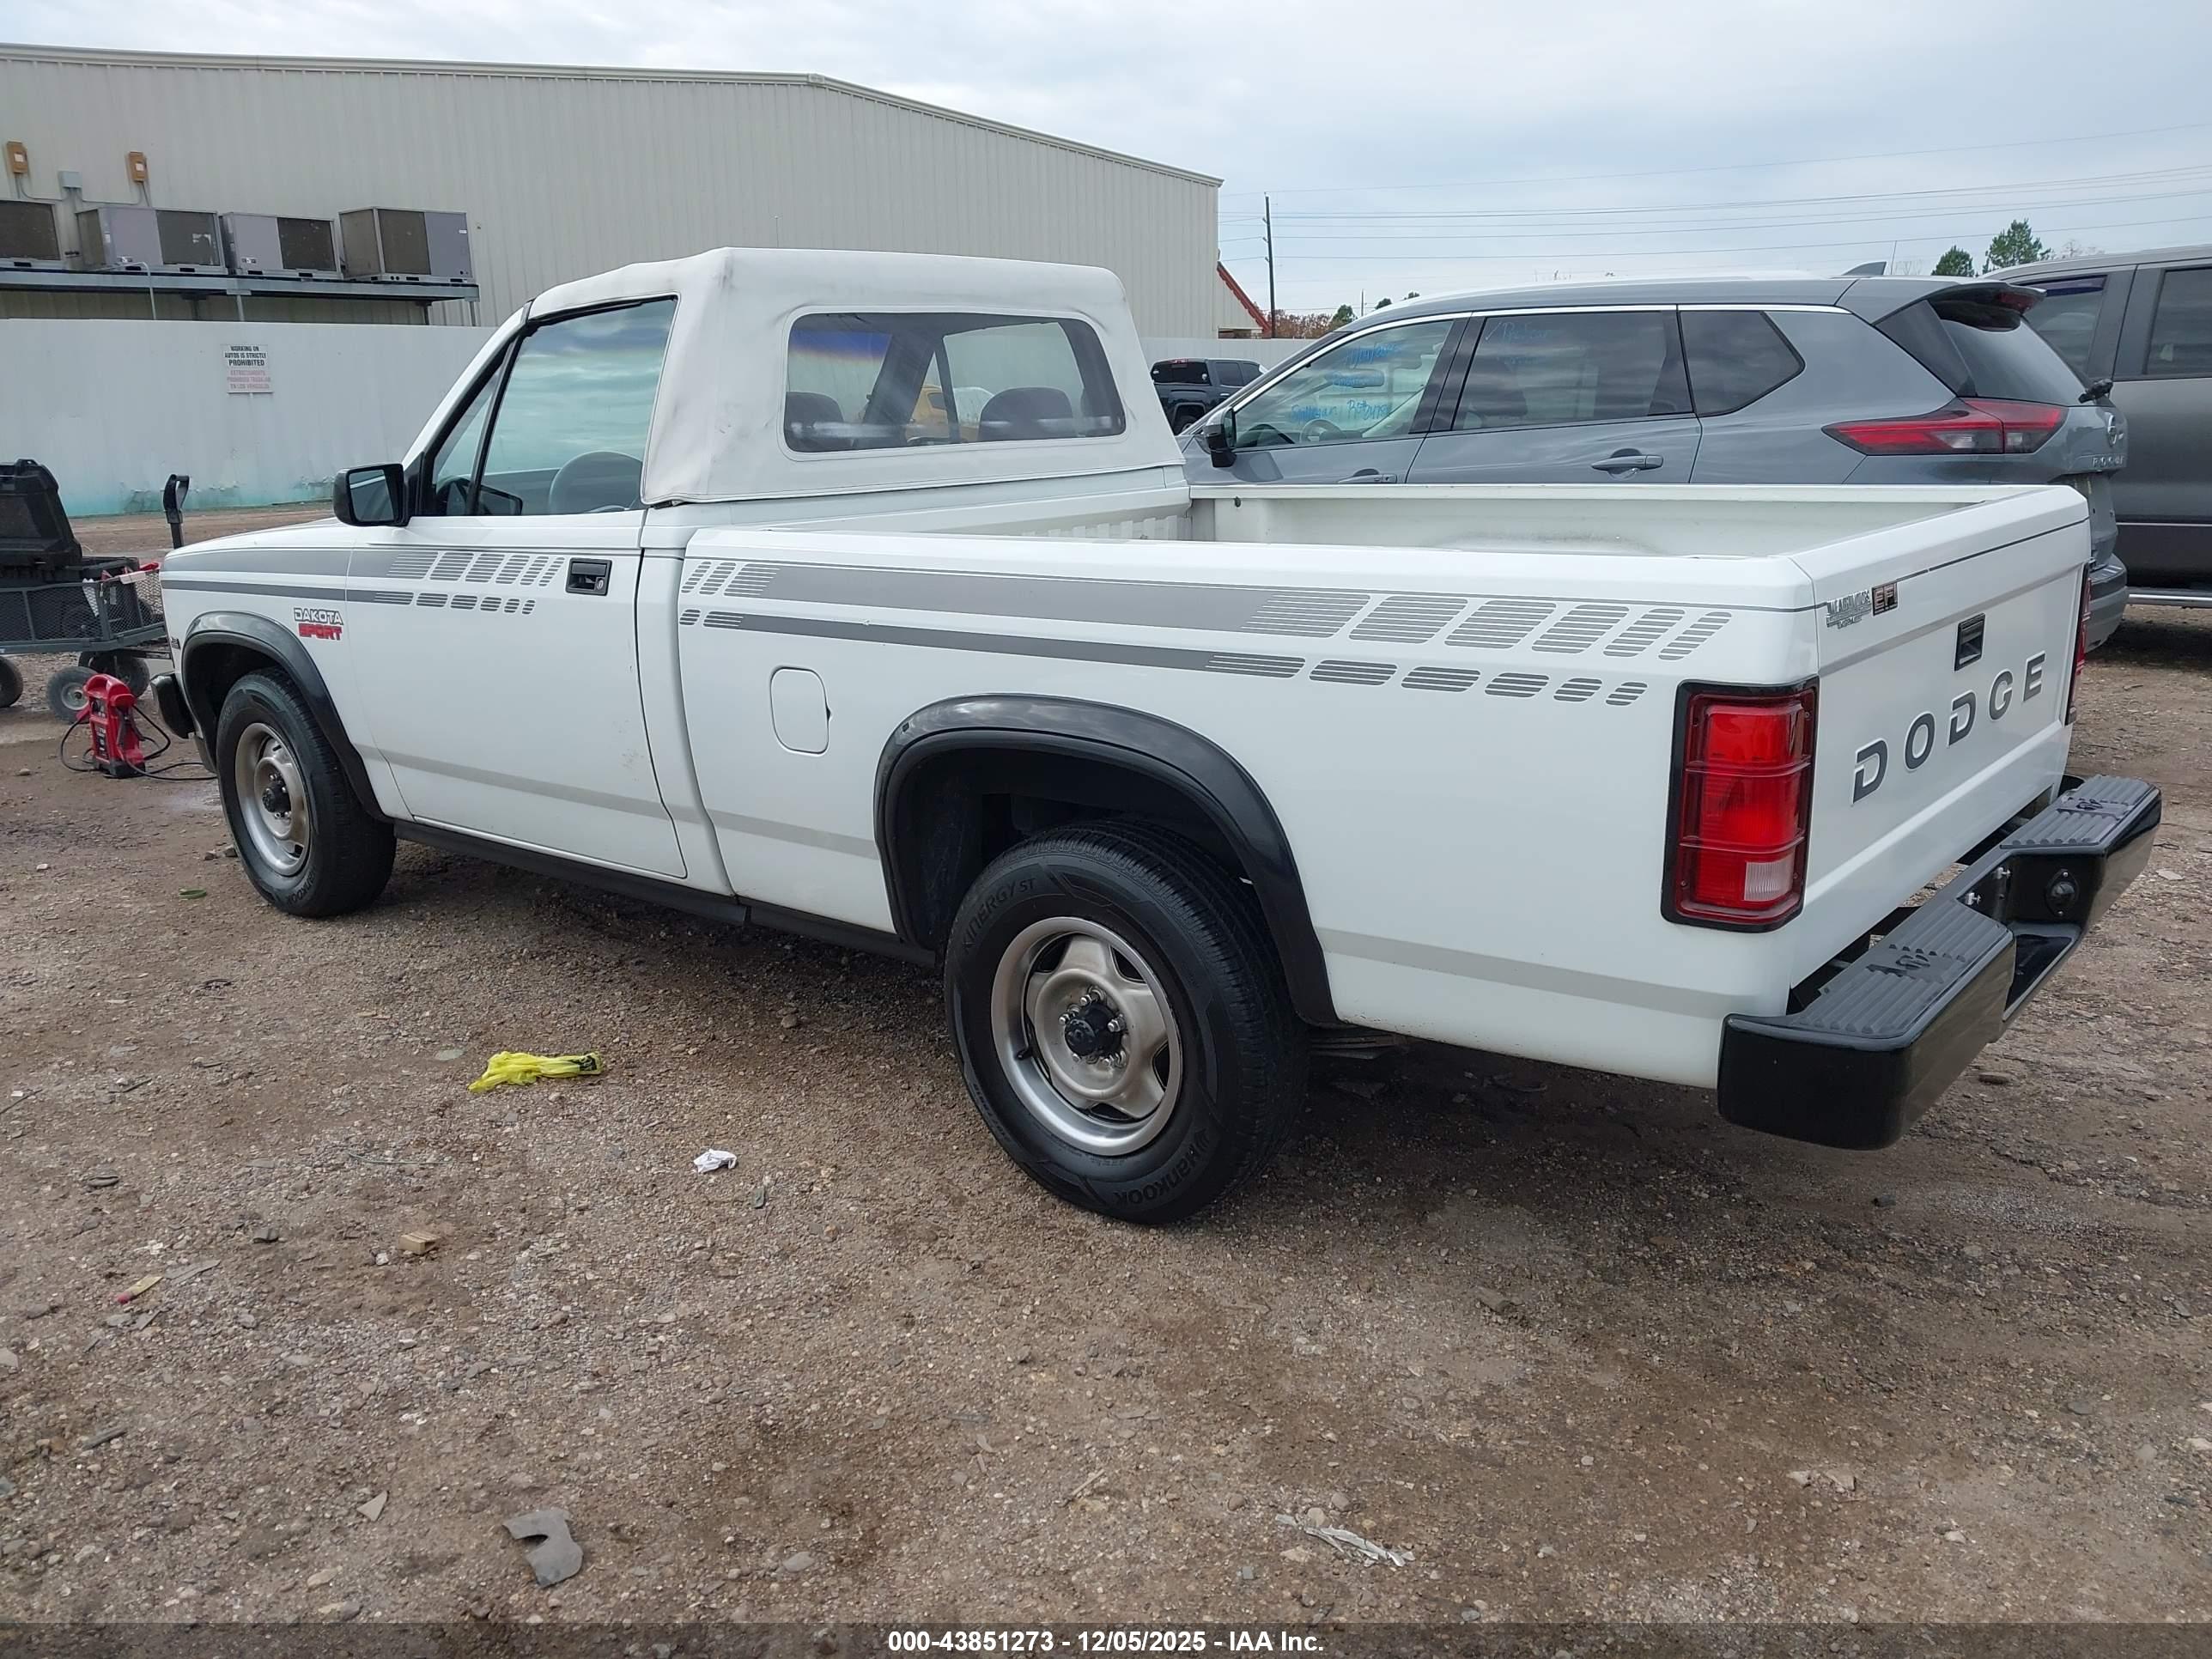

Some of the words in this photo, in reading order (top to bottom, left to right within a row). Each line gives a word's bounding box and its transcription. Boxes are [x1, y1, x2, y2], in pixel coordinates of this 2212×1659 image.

[294, 607, 343, 625] DAKOTA
[298, 623, 342, 641] SPORT
[1851, 651, 2045, 805] DODGE
[1018, 878, 1037, 893] ST
